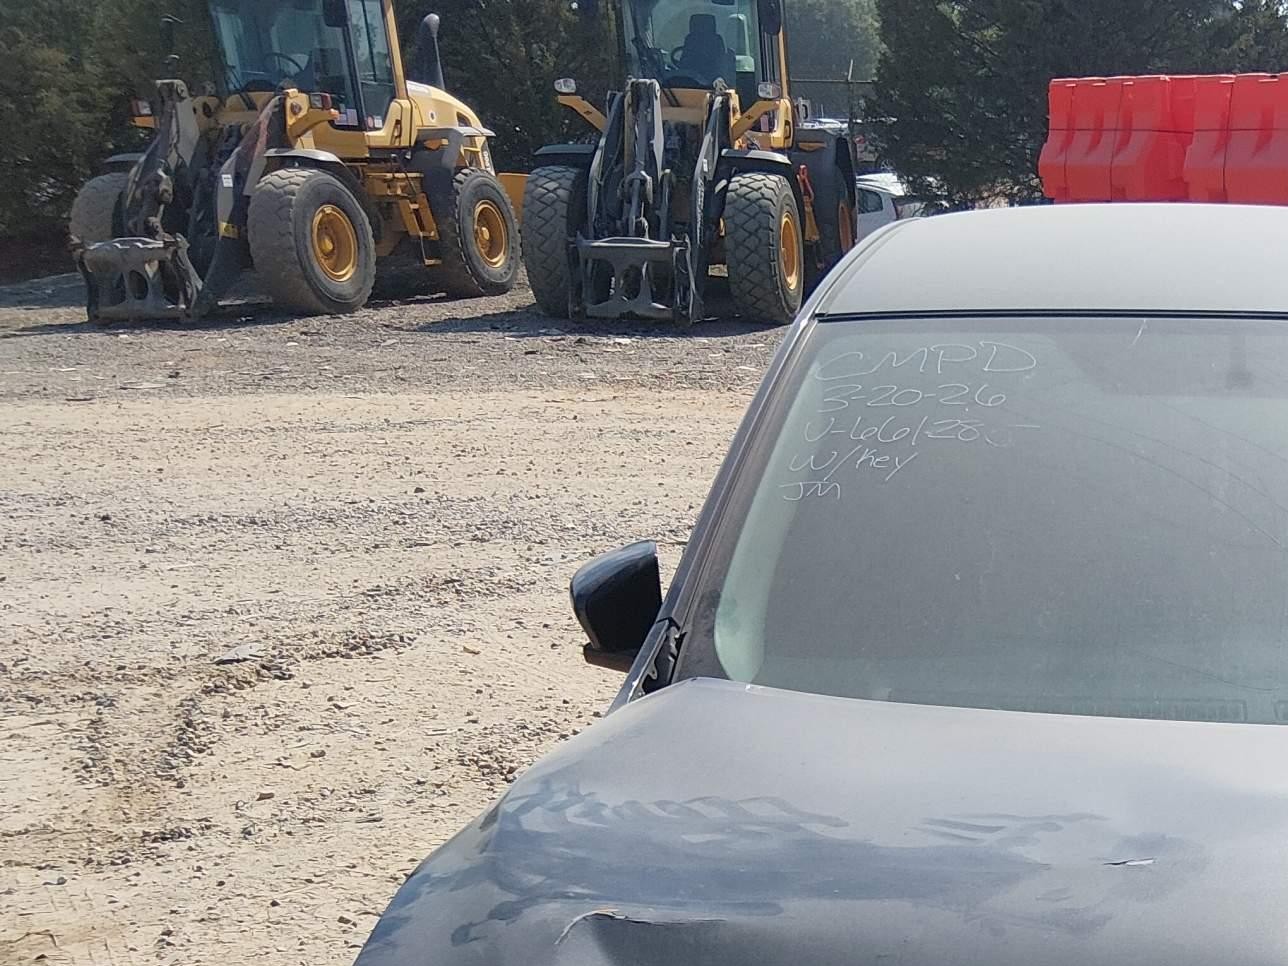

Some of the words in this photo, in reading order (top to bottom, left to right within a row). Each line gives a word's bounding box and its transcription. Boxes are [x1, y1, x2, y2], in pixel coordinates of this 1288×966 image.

[815, 341, 1037, 381] CMPD
[818, 383, 1008, 413] 3-20-26
[778, 481, 841, 501] JM
